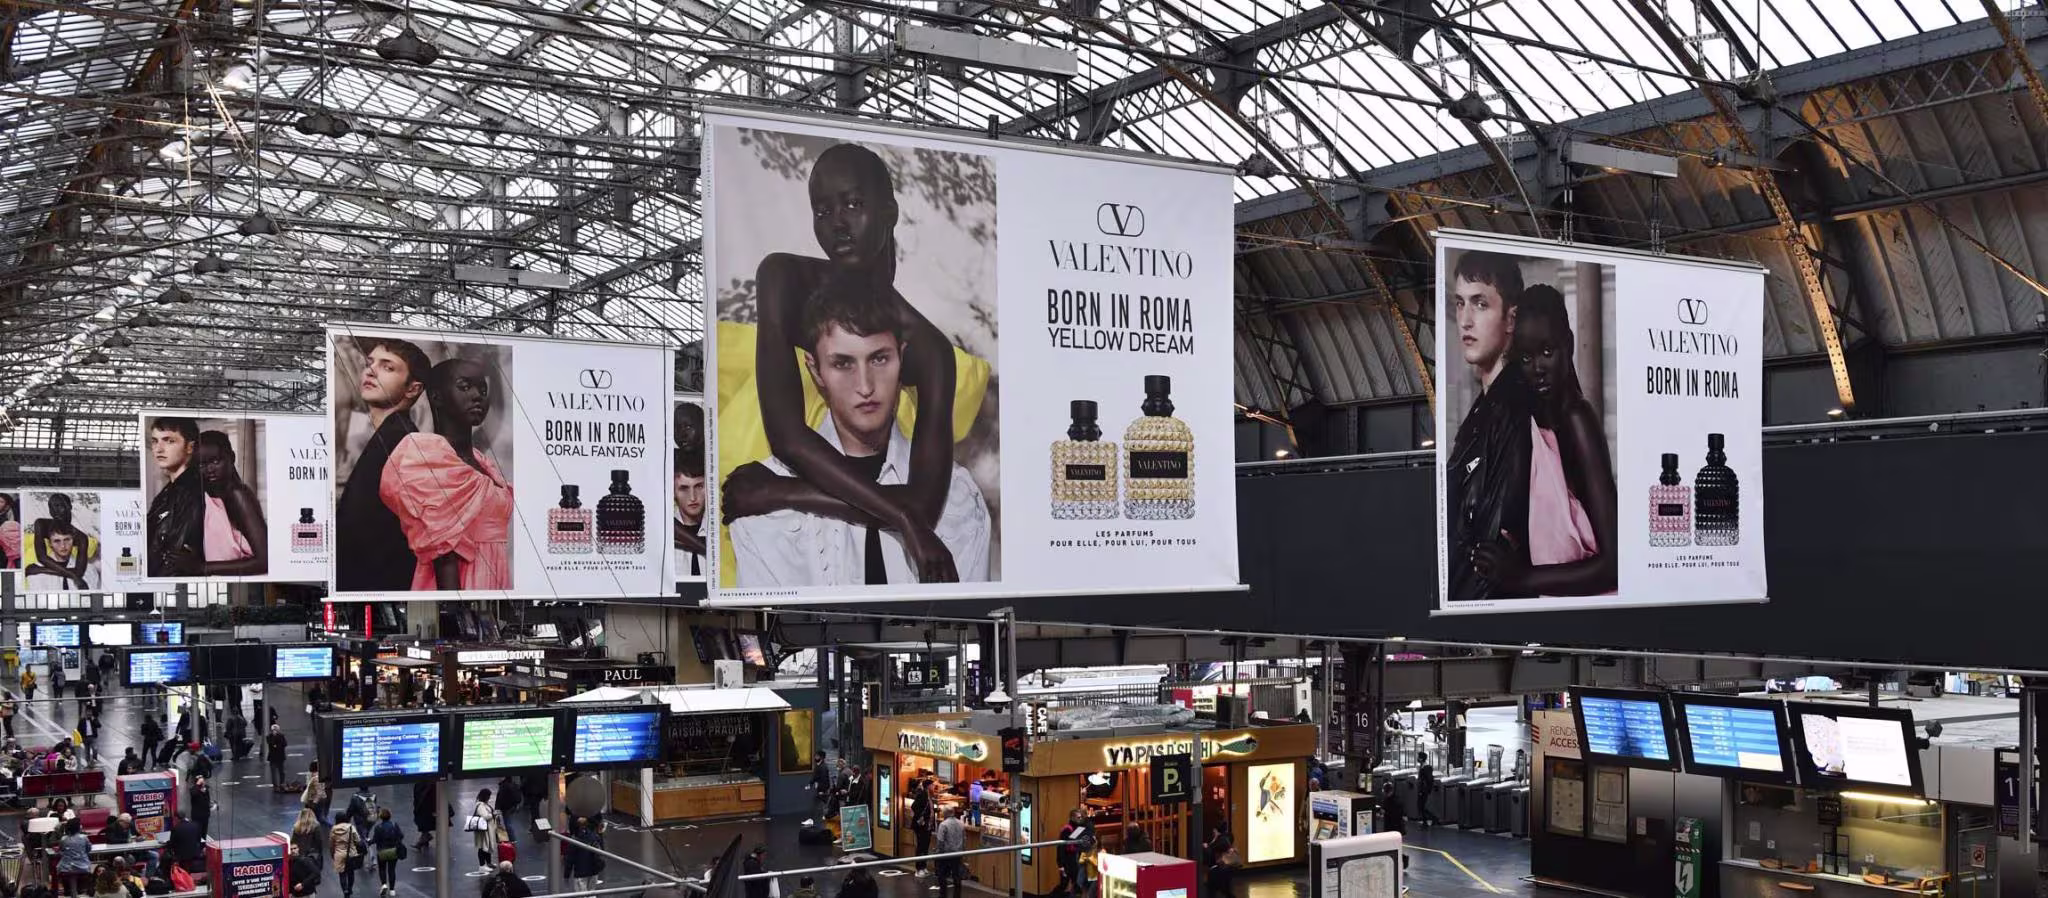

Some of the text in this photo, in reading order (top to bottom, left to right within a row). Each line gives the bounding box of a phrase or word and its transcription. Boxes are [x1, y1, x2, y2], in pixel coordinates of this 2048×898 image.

[1048, 240, 1192, 280] VALENTINO
[1048, 288, 1192, 332] BORN IN ROMA
[1048, 327, 1194, 355] YELLOW DREAM
[1646, 328, 1738, 357] VALENTINO
[1647, 366, 1738, 399] BORN IN ROMA
[546, 392, 644, 412] VALENTINO
[546, 420, 645, 444] BORN IN ROMA
[546, 444, 645, 458] CORAL FANTASY
[290, 466, 314, 480] BORN
[1137, 460, 1182, 470] VALENTINO
[604, 670, 642, 681] PAUL
[1355, 712, 1368, 728] 16
[133, 792, 164, 802] HARIBO
[234, 864, 273, 877] HARIBO
